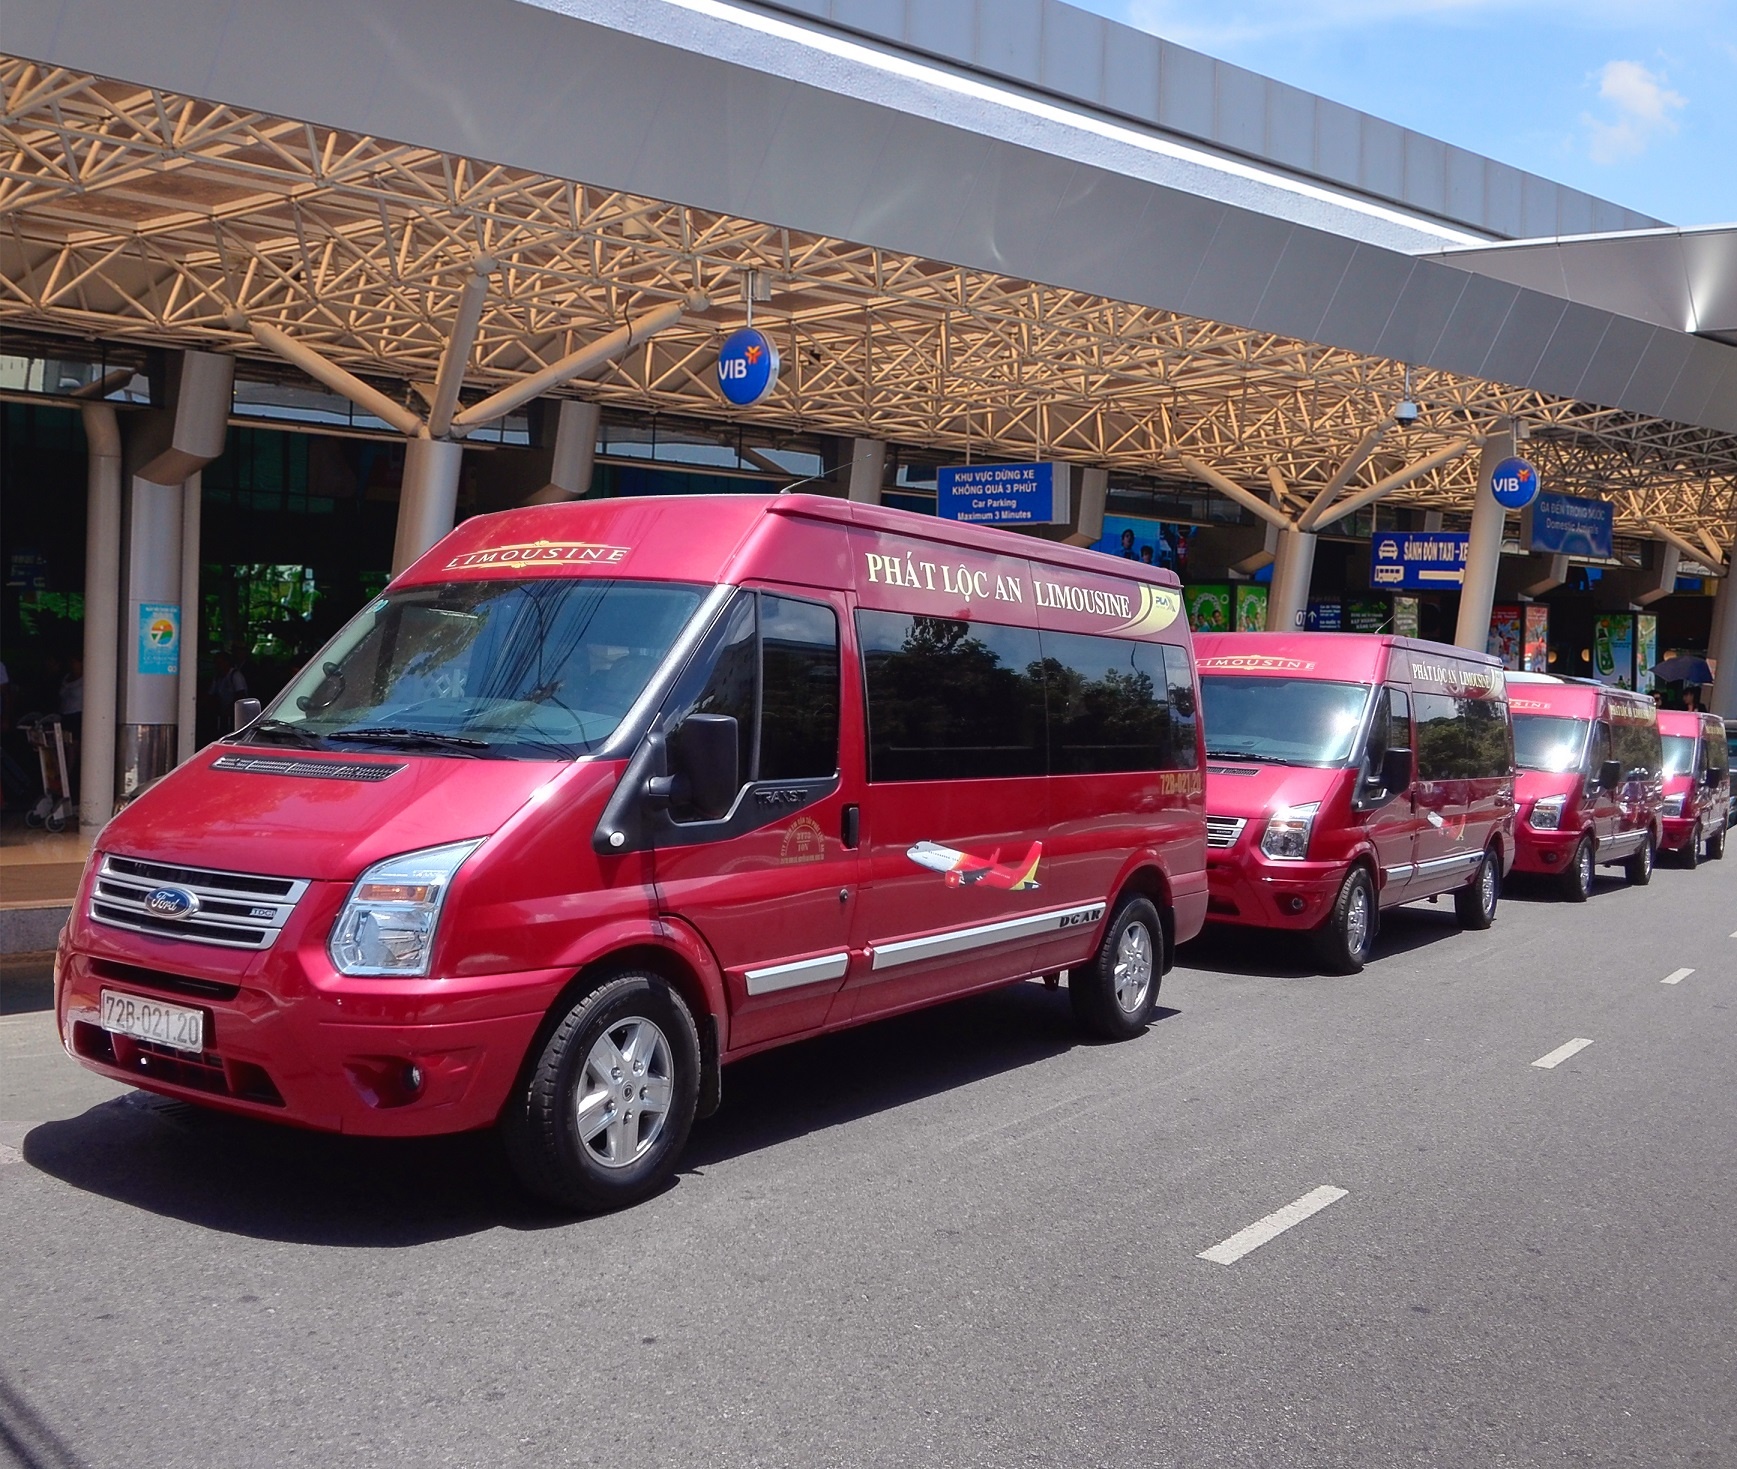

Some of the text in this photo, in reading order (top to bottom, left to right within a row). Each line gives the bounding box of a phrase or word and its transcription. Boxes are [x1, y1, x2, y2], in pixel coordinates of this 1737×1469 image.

[719, 359, 747, 380] VIB
[955, 473, 973, 482] KHU
[975, 471, 993, 482] VỰC
[1023, 470, 1034, 479] XE
[1493, 478, 1519, 492] VIB
[952, 484, 983, 495] KHÔNG
[1006, 484, 1011, 493] 3
[1013, 482, 1037, 493] PHÚT
[972, 498, 1017, 508] Car Parking
[957, 511, 1031, 520] Maximum 3 Minutes
[446, 548, 627, 568] LIMOUSINE
[1439, 542, 1454, 561] TAXI
[865, 551, 1132, 619] PHÁT LỘC AN LIMOUSINE
[1412, 661, 1433, 681] PHÁT
[1433, 665, 1448, 685] LỘC
[151, 891, 180, 912] Ford
[106, 995, 199, 1046] 72B-021.20
